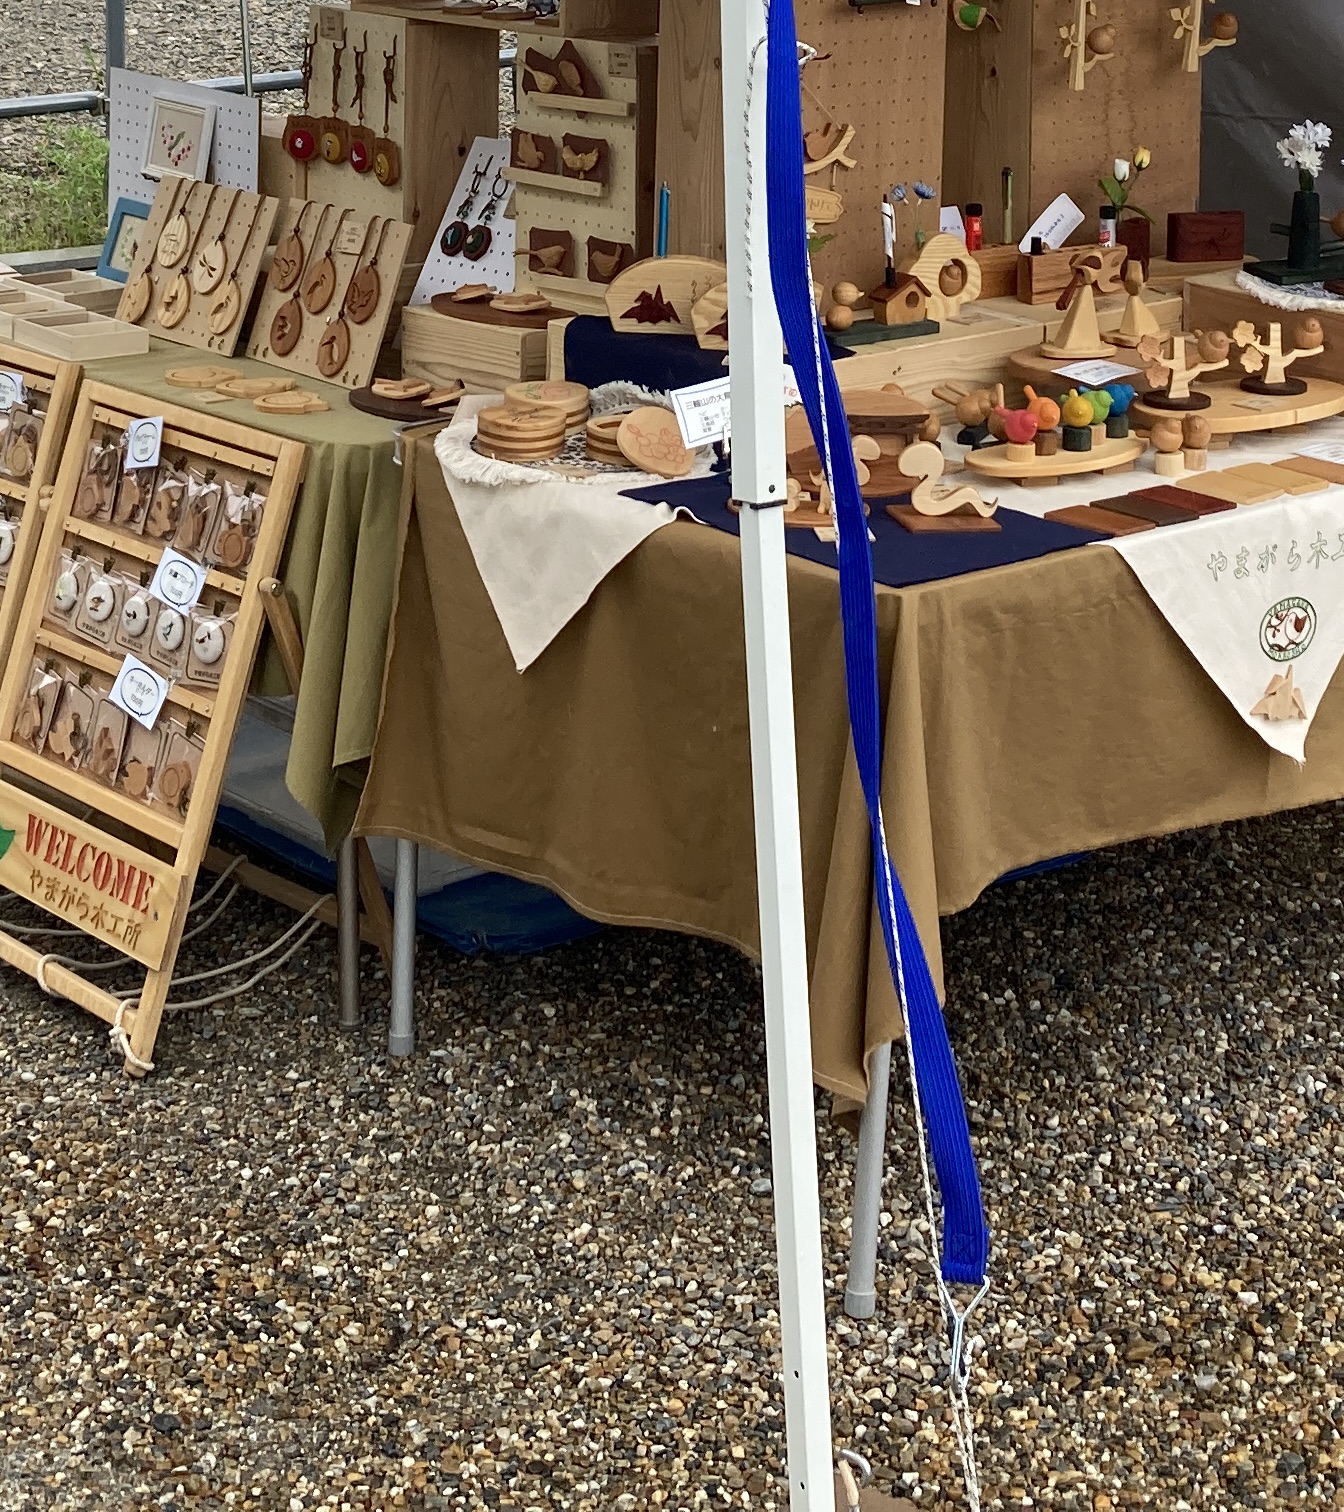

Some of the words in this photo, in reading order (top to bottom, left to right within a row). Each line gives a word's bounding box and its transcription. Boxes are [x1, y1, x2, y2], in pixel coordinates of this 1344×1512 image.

[25, 813, 155, 915] WELCOME
[29, 868, 142, 951] やまがら木工所
